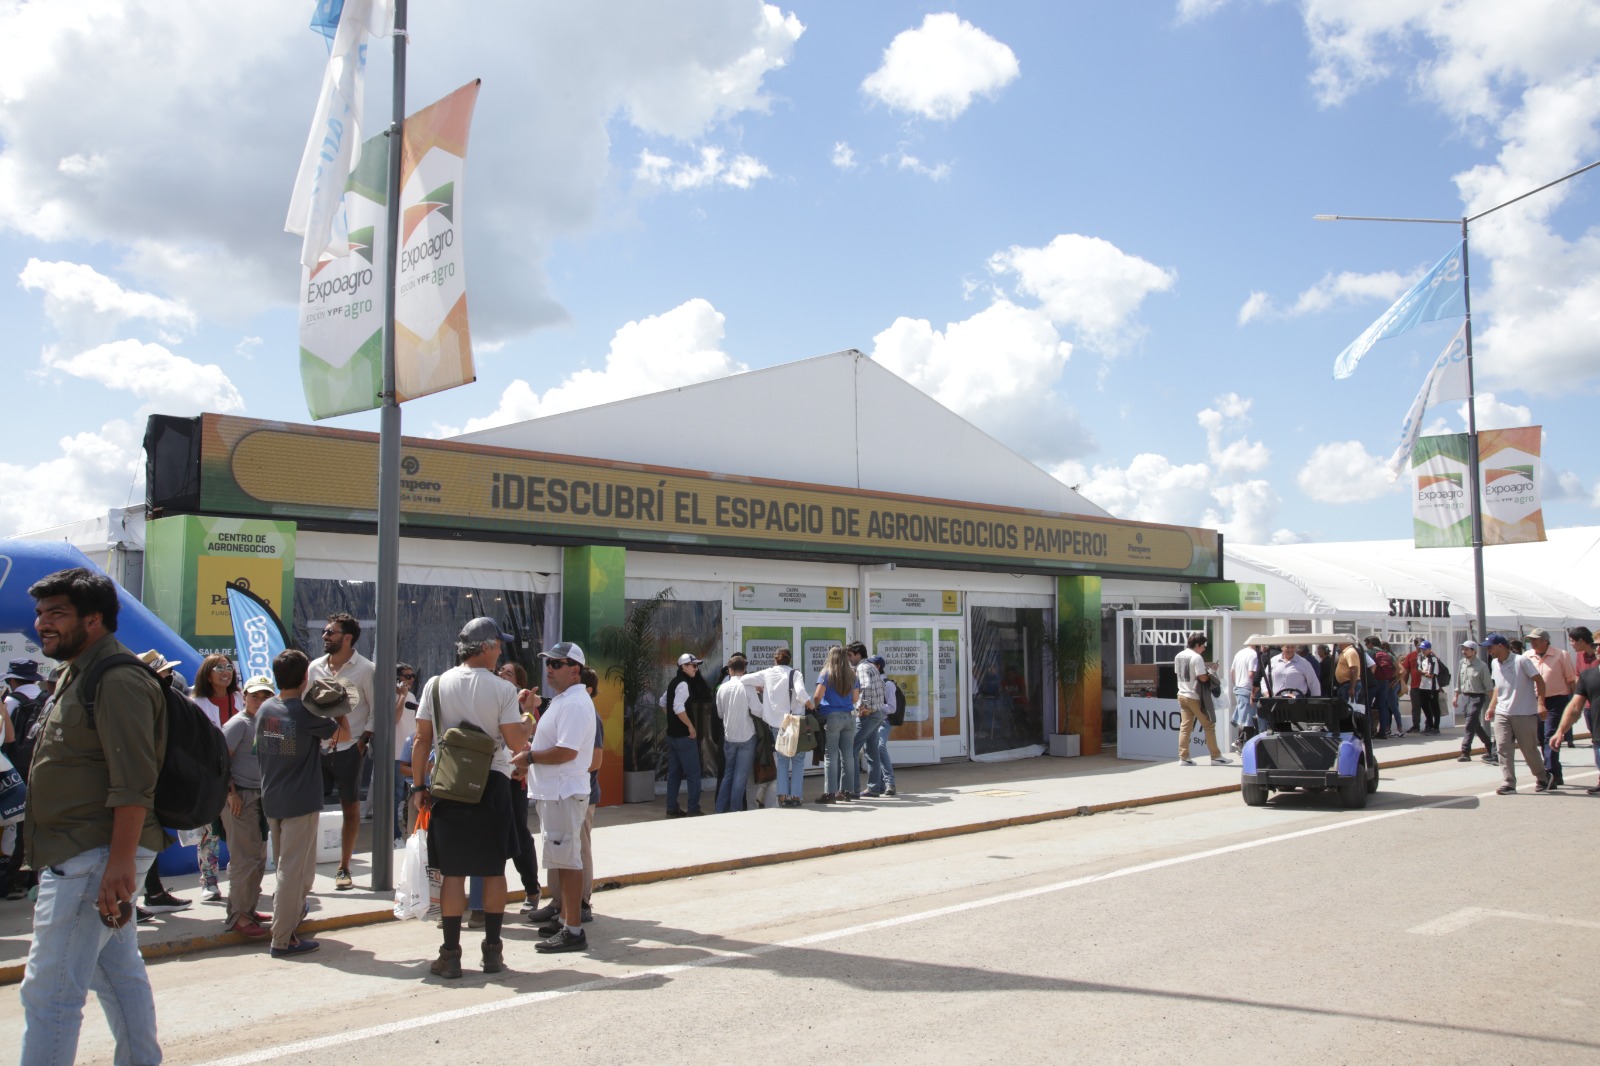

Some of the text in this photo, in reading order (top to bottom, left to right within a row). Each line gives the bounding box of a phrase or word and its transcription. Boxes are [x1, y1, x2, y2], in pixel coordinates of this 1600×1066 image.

[401, 228, 454, 273] Expoagro
[417, 272, 431, 285] YPF
[431, 262, 455, 286] agro
[308, 268, 373, 303] Expoagro
[327, 306, 343, 317] YPF
[344, 299, 372, 319] agro
[400, 479, 441, 491] mpero
[1486, 482, 1533, 495] Expoagro
[1418, 490, 1463, 501] Expoagro
[1514, 495, 1534, 505] agro
[491, 472, 1107, 557] ¡DESCUBRÍ EL ESPACIO DE AGRONEGOCIOS PAMPERO!
[218, 533, 267, 544] CENTRO DE
[208, 543, 276, 553] AGRONEGOCIOS
[1388, 598, 1451, 618] STARLINK
